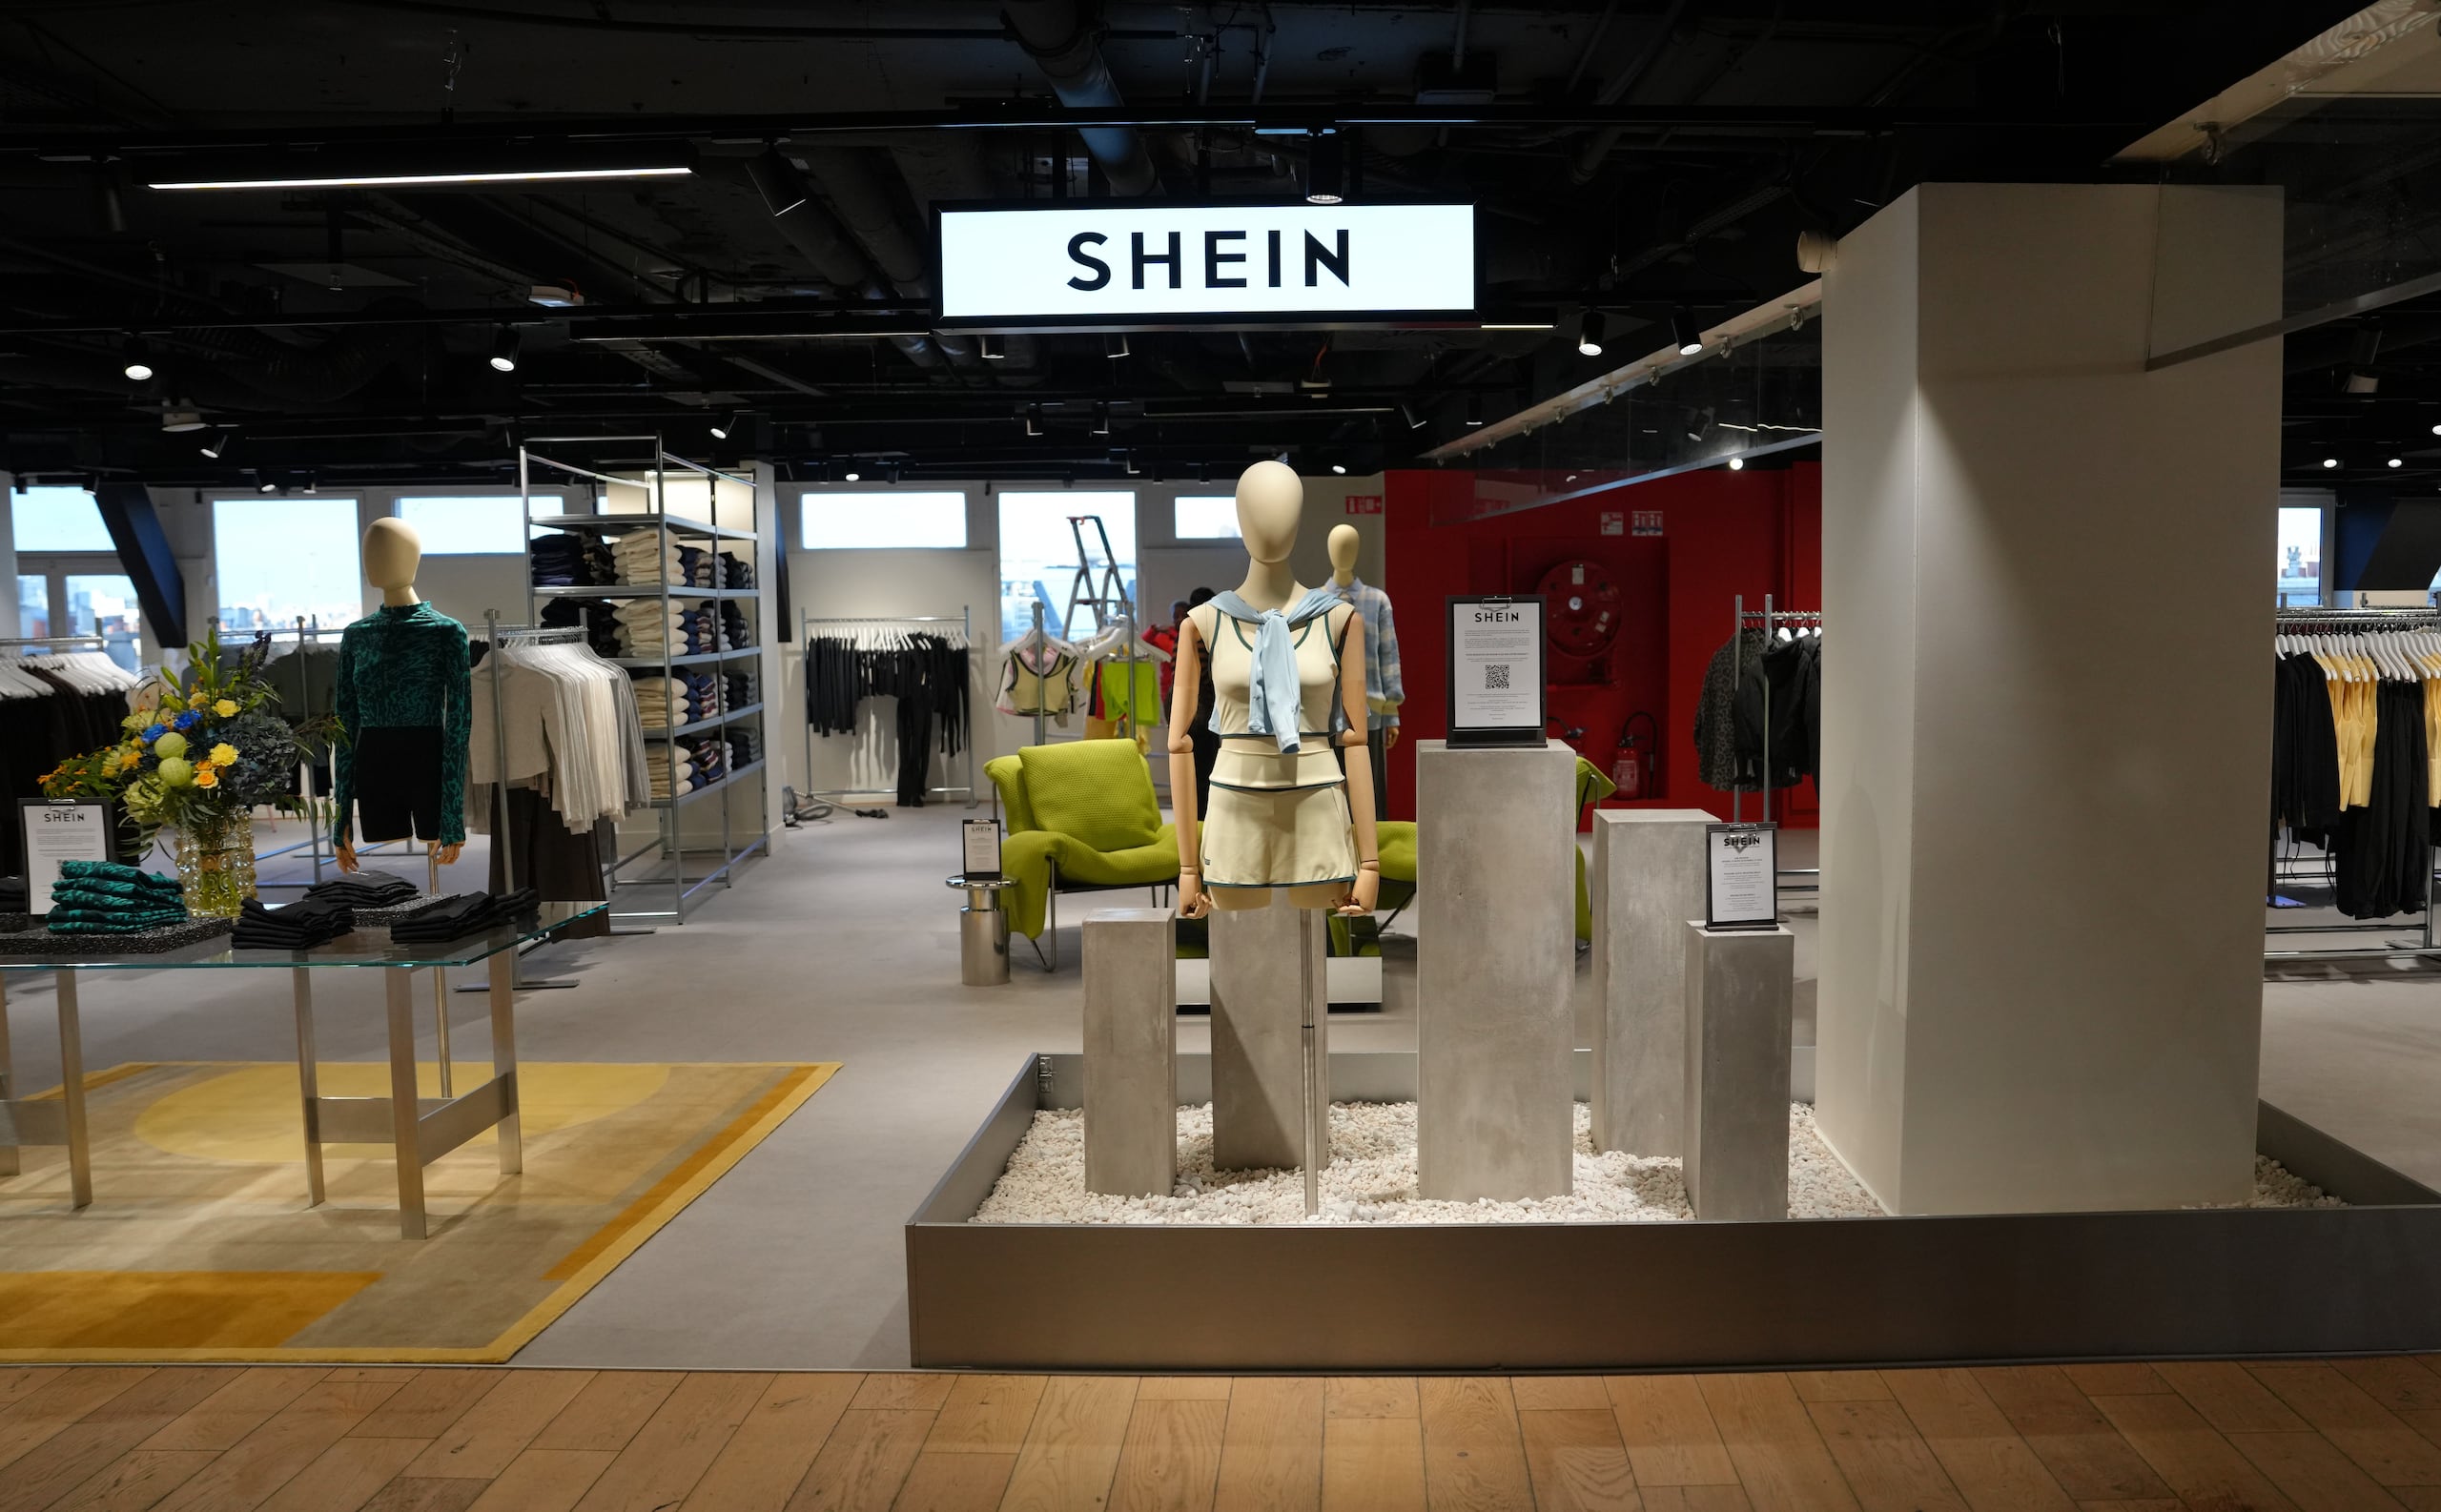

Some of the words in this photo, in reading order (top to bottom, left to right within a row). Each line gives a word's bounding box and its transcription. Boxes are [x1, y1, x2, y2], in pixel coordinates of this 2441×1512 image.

[1066, 228, 1350, 292] SHEIN
[1474, 612, 1520, 623] SHEIN
[44, 813, 85, 823] SHEIN
[1723, 836, 1760, 847] SHEIN
